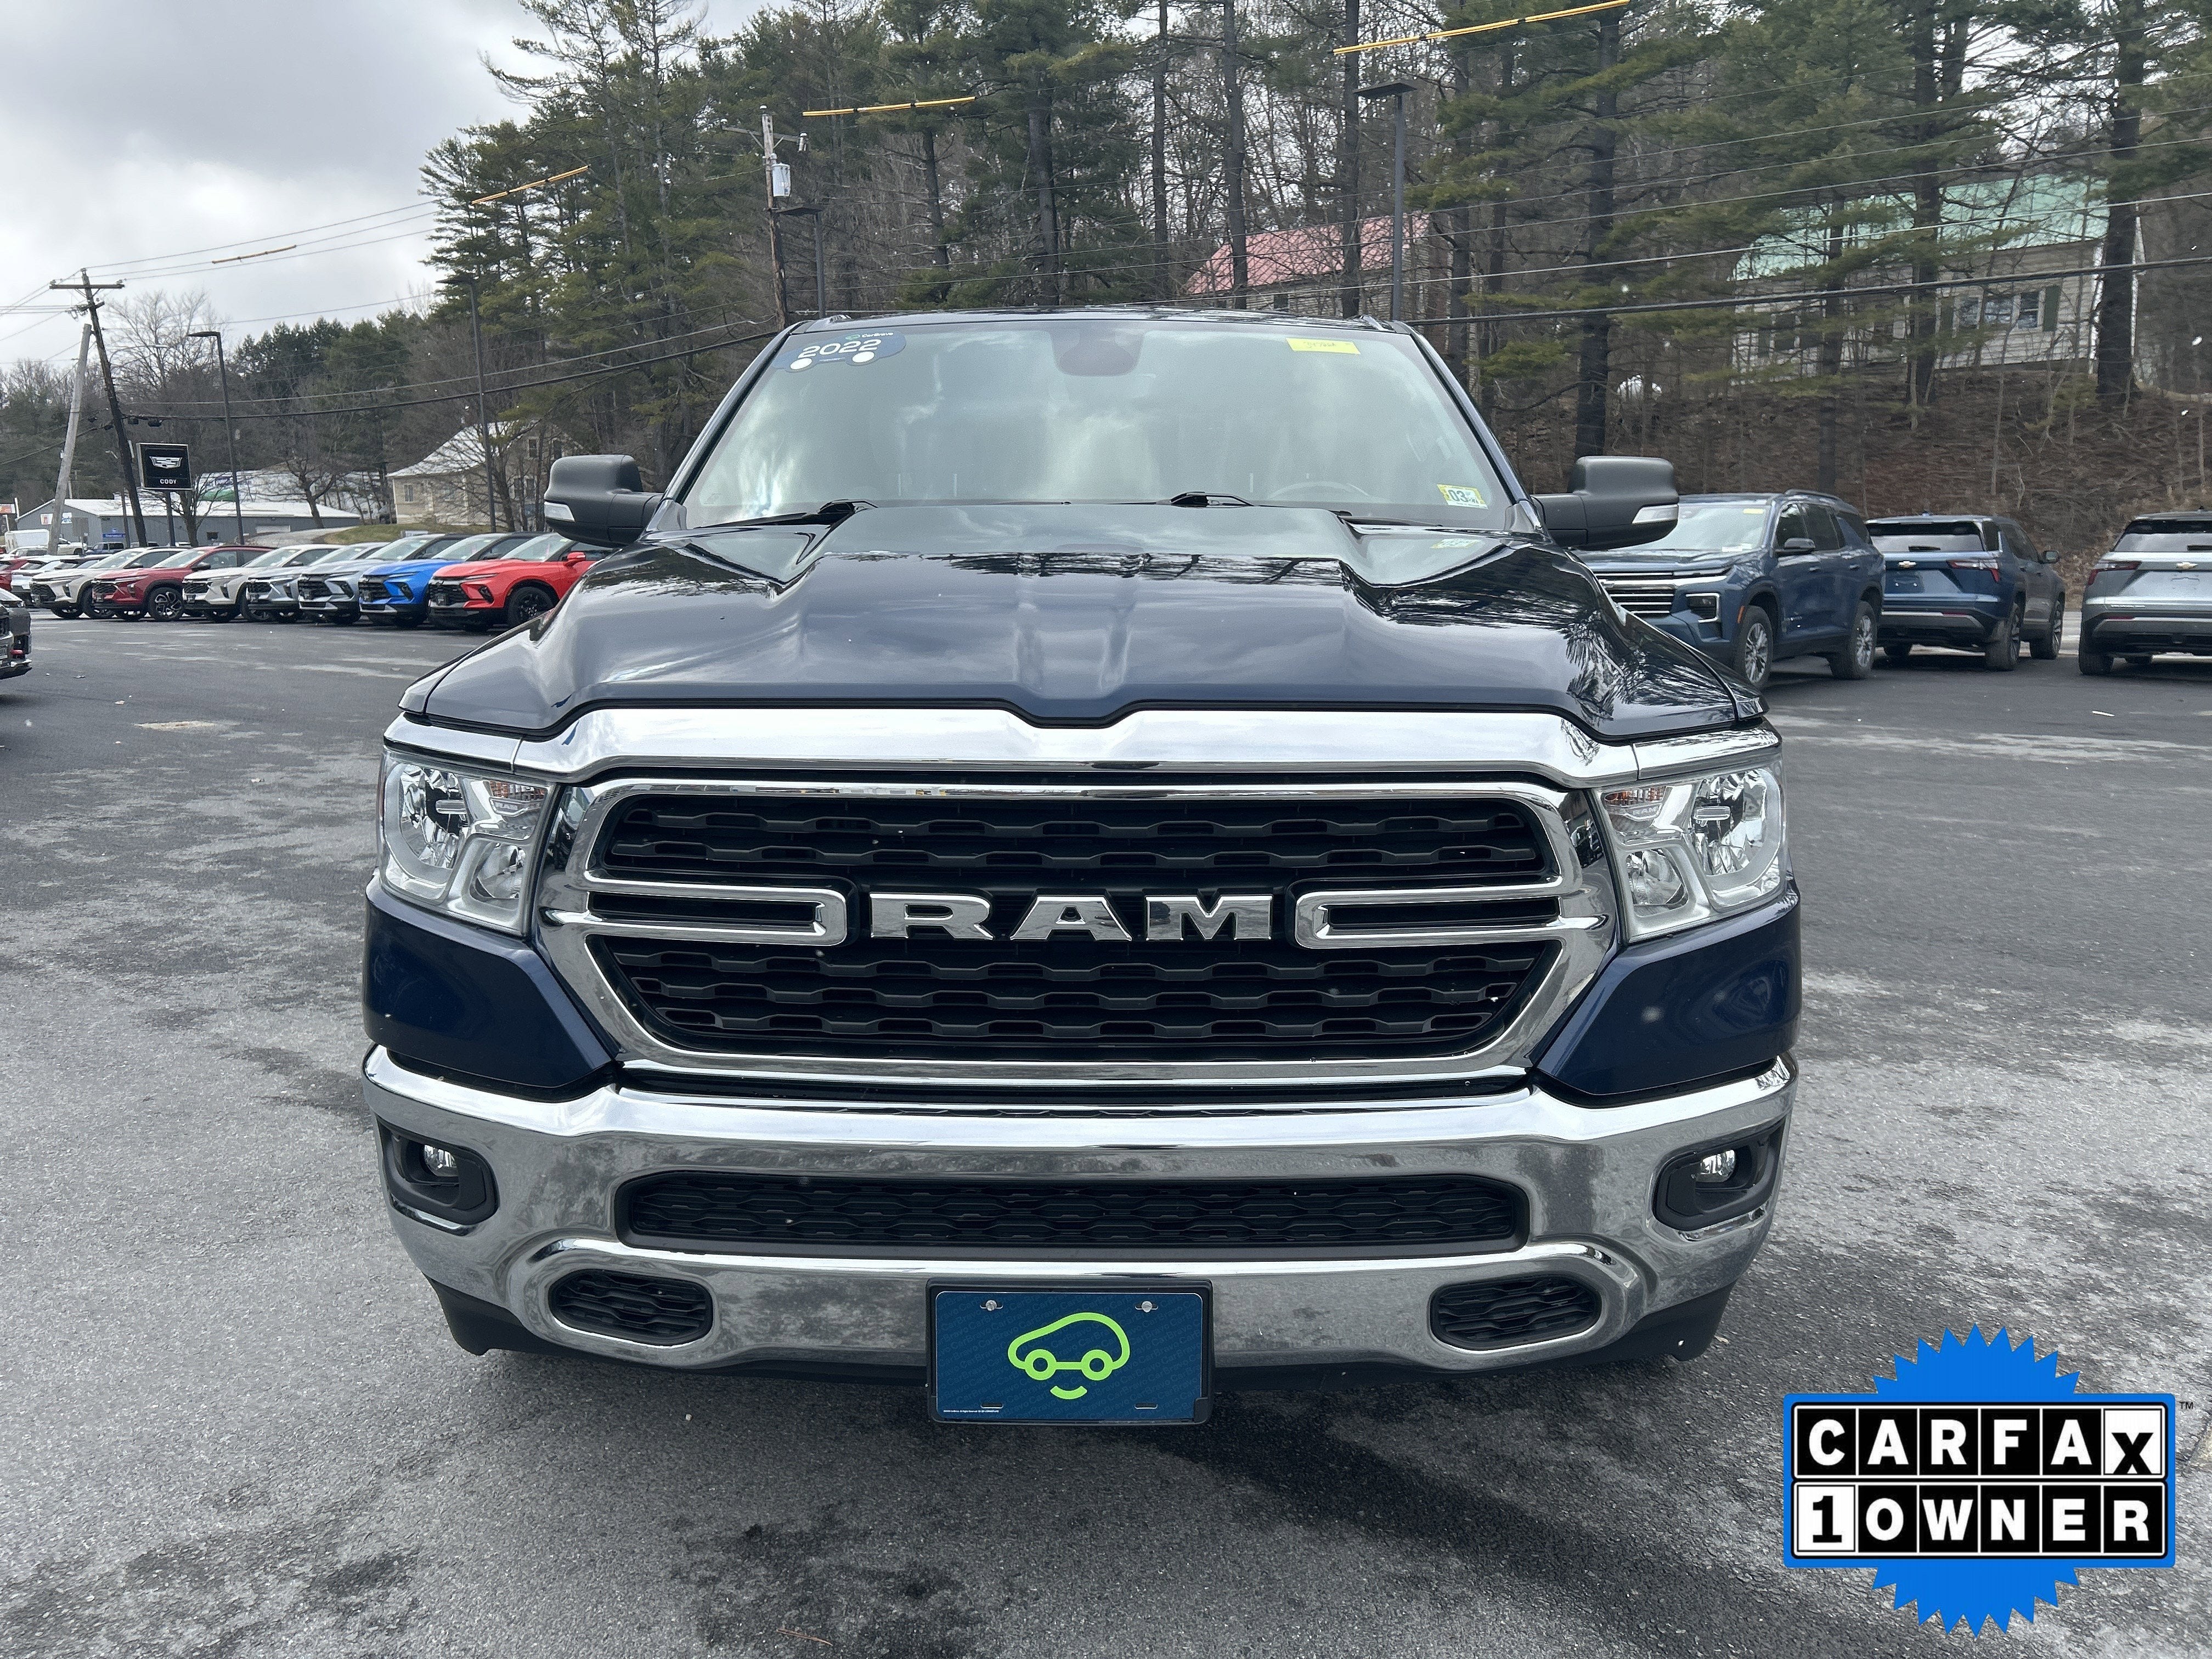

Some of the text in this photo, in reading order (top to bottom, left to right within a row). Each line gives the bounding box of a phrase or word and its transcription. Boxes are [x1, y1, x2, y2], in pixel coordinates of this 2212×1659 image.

[798, 339, 882, 358] 2022
[1448, 489, 1469, 503] 03
[870, 892, 1273, 941] RAM
